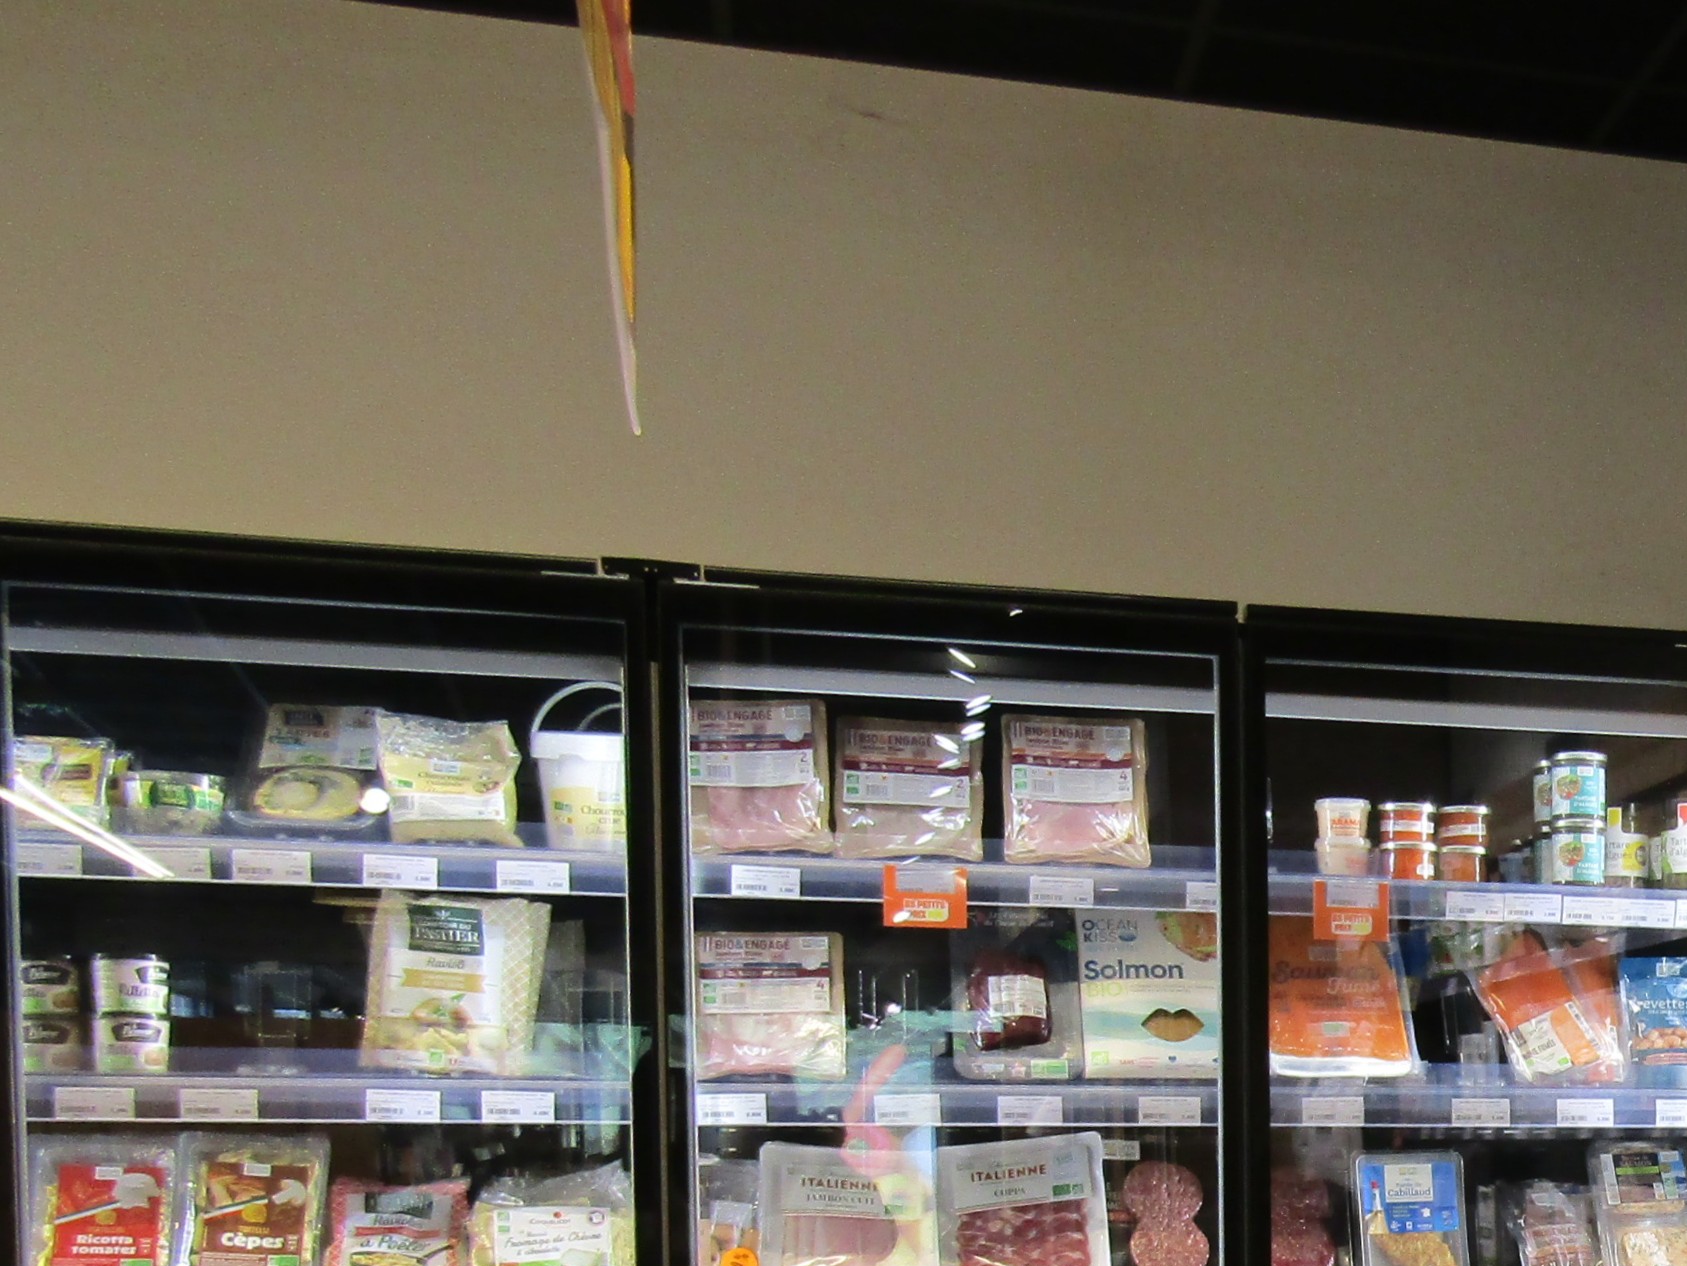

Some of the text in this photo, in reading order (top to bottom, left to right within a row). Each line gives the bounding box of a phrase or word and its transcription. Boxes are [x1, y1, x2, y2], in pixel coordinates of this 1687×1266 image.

[1082, 919, 1138, 932] OCEAN
[1088, 982, 1122, 997] BIO
[971, 1164, 1047, 1182] ITALIENNE
[1388, 1186, 1431, 1197] Cabillaud
[220, 1231, 284, 1250] Cèpes
